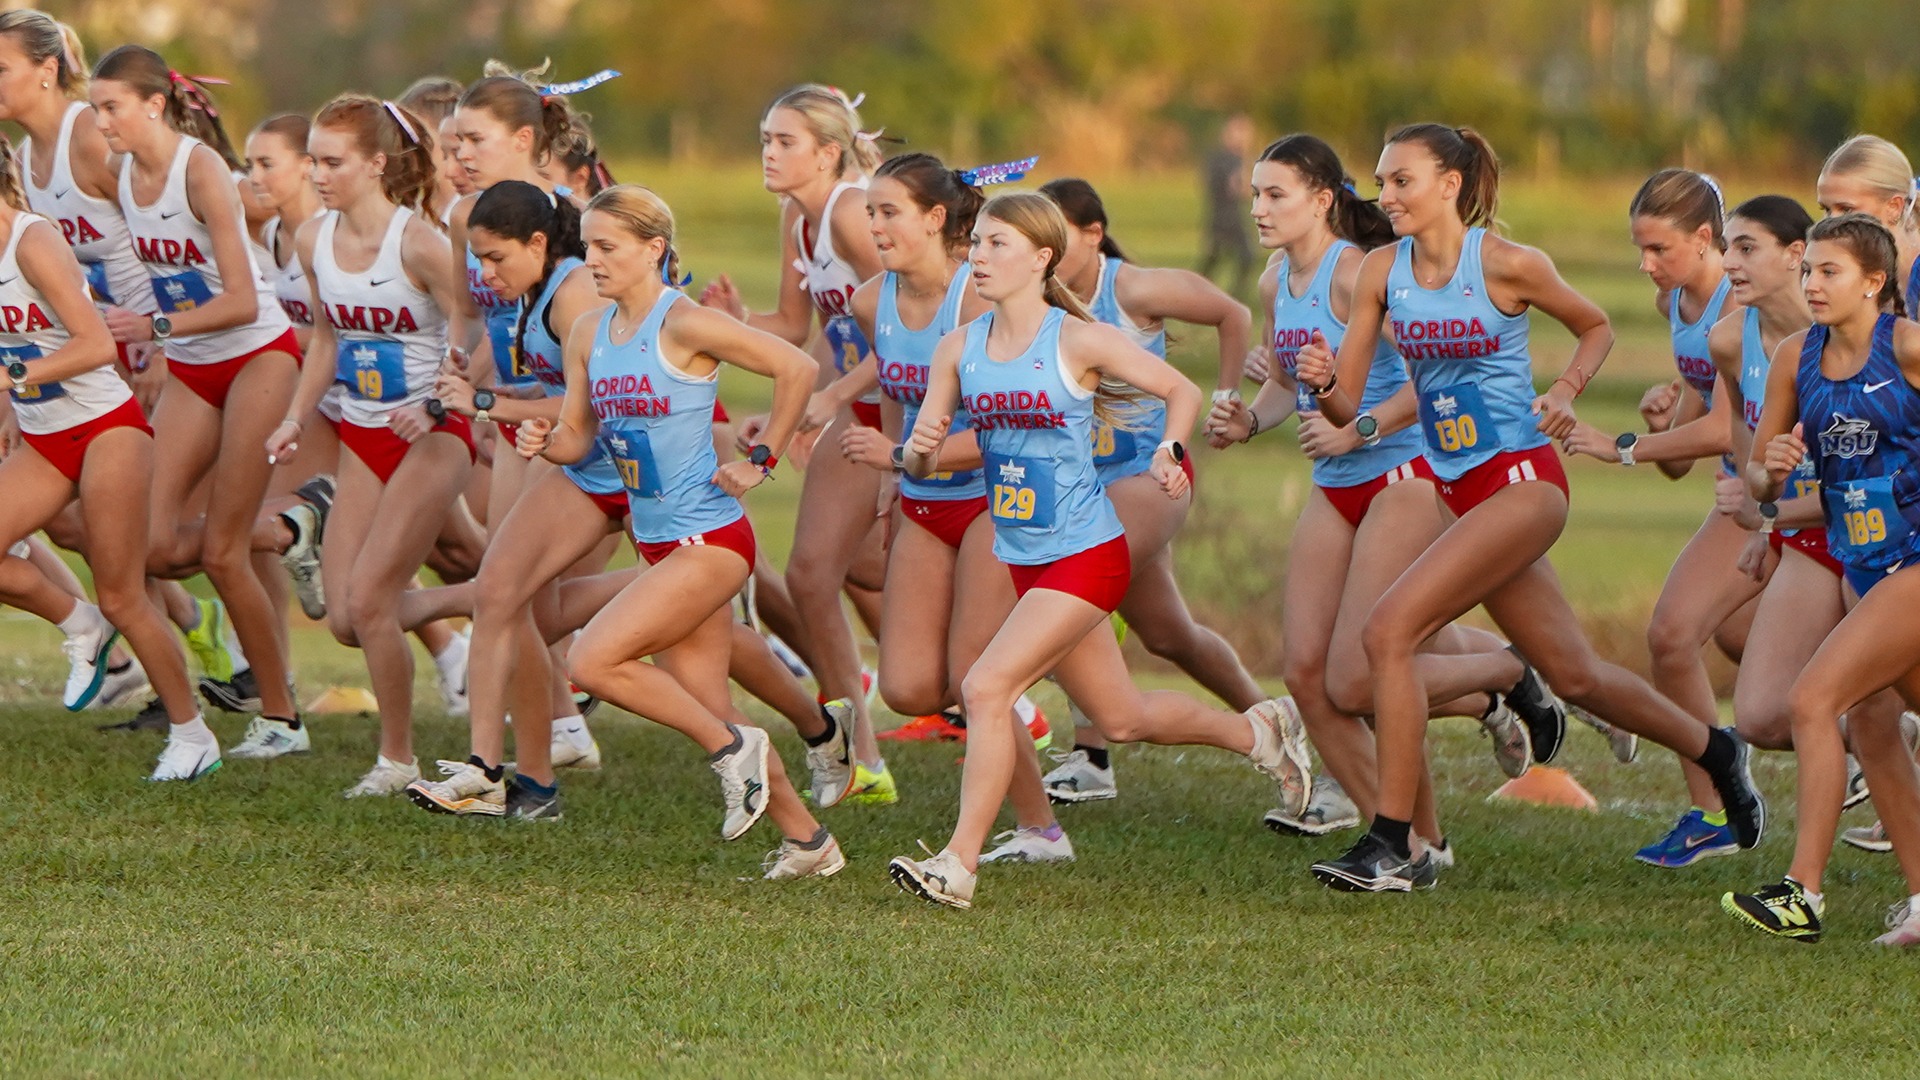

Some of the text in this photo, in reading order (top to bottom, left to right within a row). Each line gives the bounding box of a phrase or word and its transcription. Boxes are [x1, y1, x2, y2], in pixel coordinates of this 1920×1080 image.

[0, 303, 54, 333] PA
[1392, 317, 1487, 342] FLORIDA
[1434, 413, 1478, 453] 130
[1818, 430, 1878, 459] NSU
[993, 484, 1036, 520] 129
[1843, 507, 1887, 546] 189
